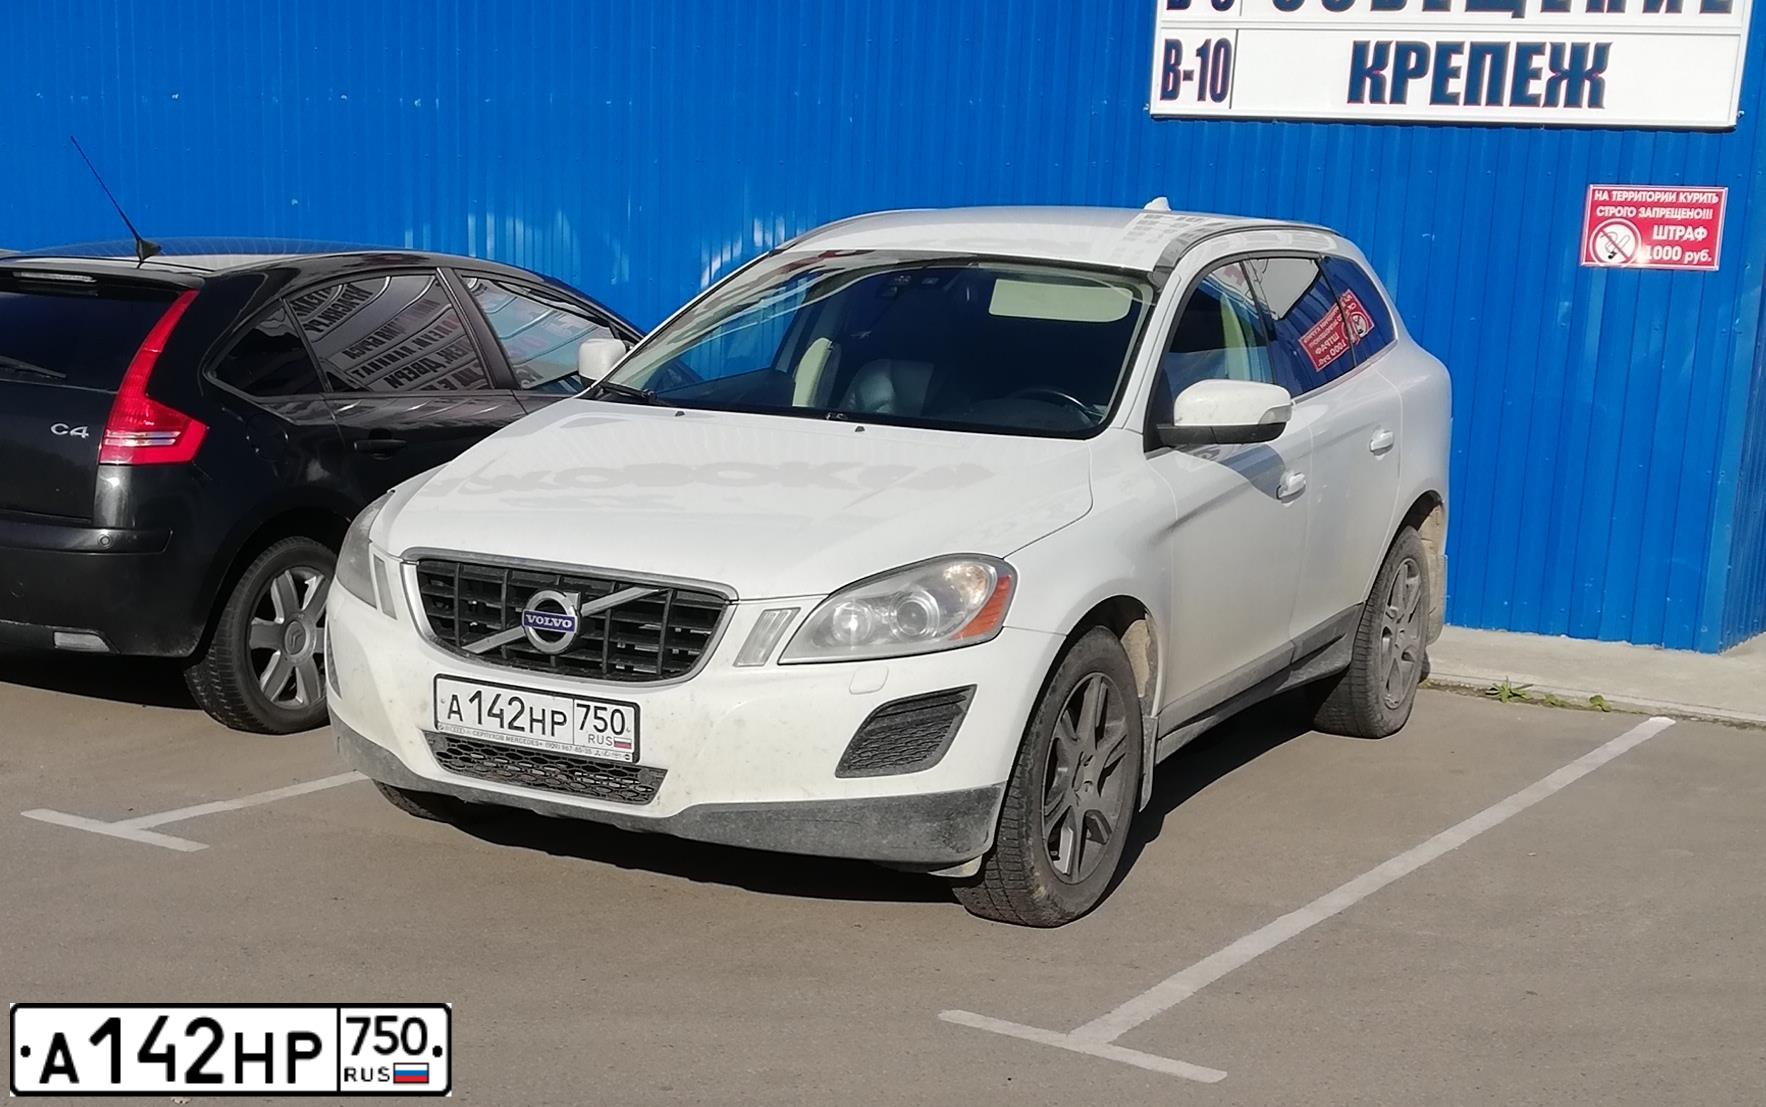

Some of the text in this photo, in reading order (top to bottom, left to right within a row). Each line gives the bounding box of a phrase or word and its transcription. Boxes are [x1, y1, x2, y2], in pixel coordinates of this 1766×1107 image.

[1160, 38, 1613, 109] В-10 КРЕПЕЖ
[1594, 190, 1719, 204] НА ТЕРРИТОРИИ КУРИТЬ
[1596, 206, 1713, 220] СТРОГО ЗАПРЕЩЕНО!!!
[1652, 224, 1708, 241] ШТРАФ
[1684, 249, 1712, 264] руб.
[51, 423, 89, 438] C4
[526, 614, 572, 628] VOLVO
[576, 703, 626, 735] 750
[587, 733, 613, 747] RUS
